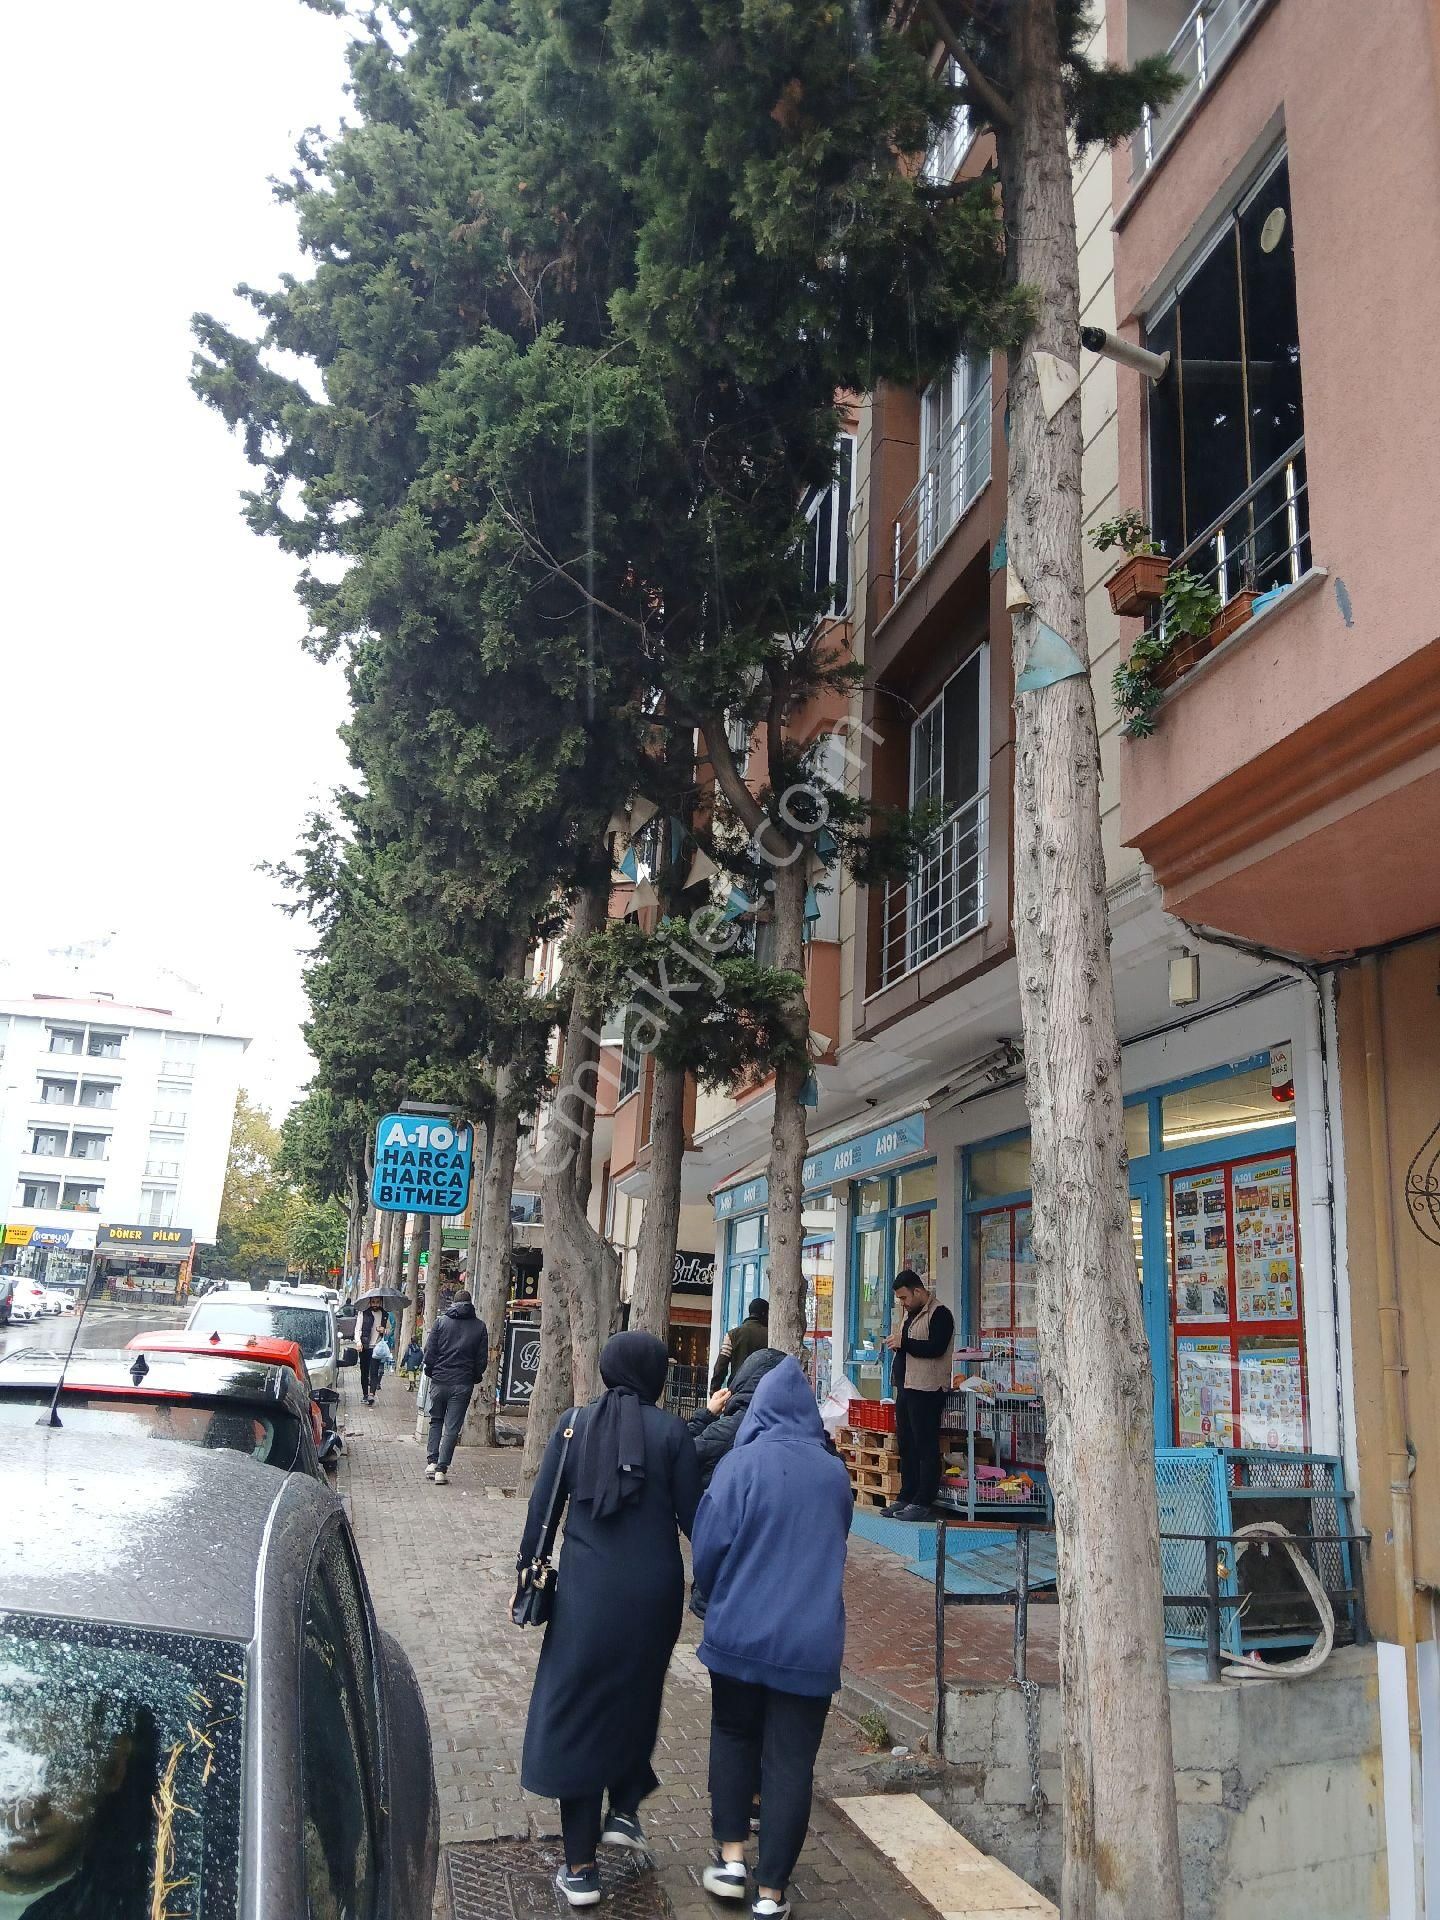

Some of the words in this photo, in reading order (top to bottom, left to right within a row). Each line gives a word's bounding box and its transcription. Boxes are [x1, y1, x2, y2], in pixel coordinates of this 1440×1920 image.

[383, 1149, 465, 1170] HARCA
[382, 1167, 463, 1188] HARCA
[109, 1228, 143, 1240] DÖNER
